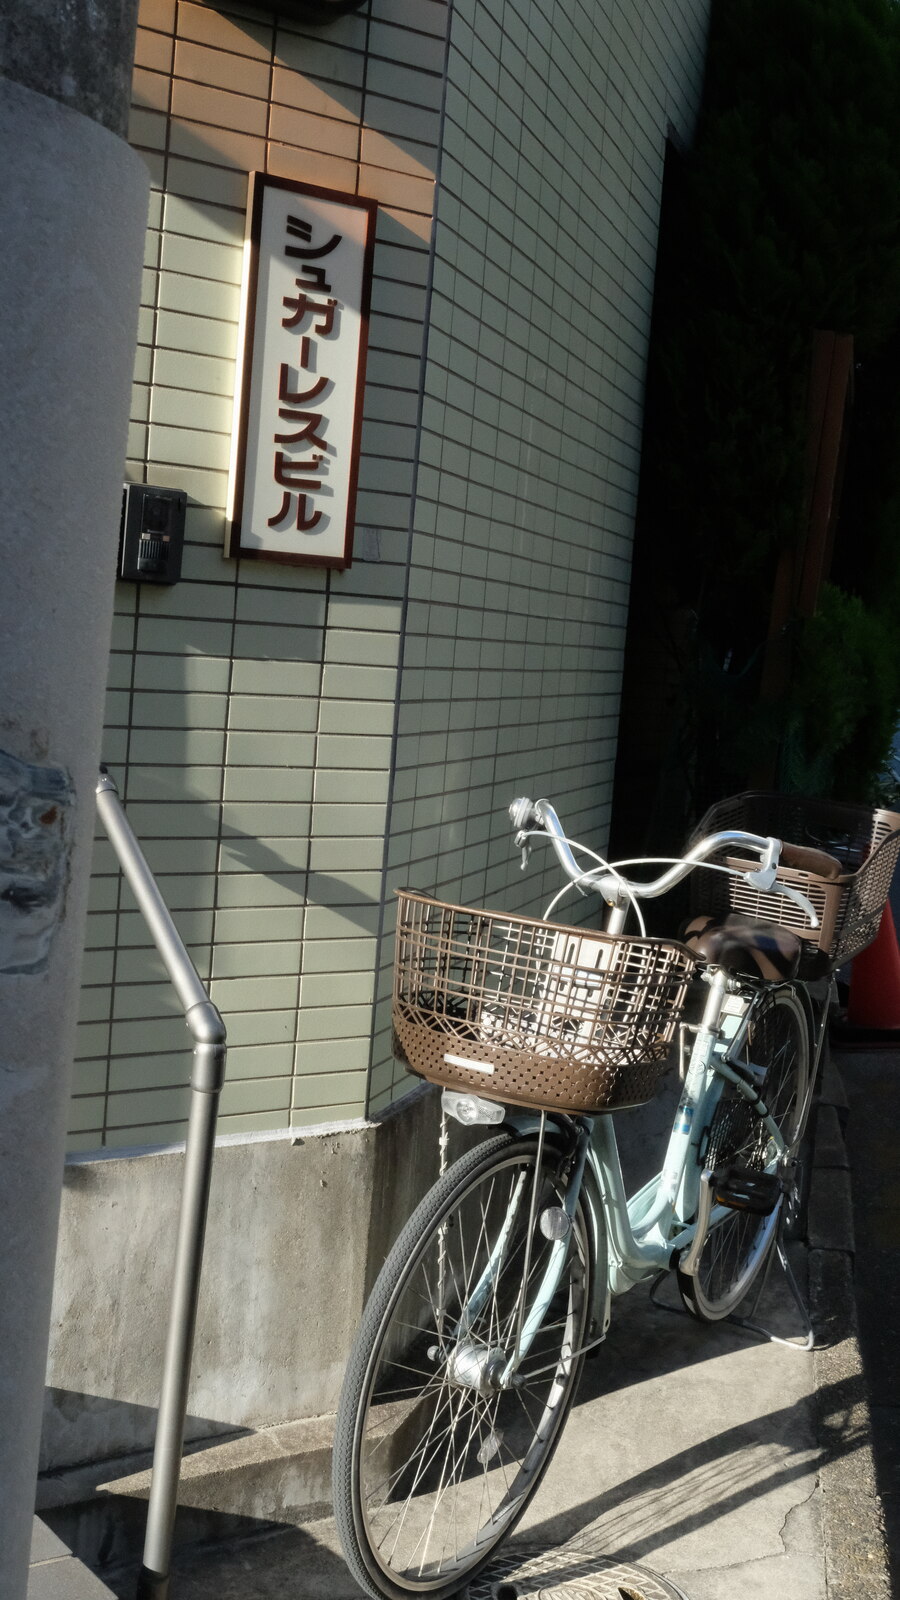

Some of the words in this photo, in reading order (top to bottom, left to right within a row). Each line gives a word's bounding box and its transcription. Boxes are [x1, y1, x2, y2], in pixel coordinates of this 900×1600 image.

[267, 214, 343, 531] シュガーレスビル
